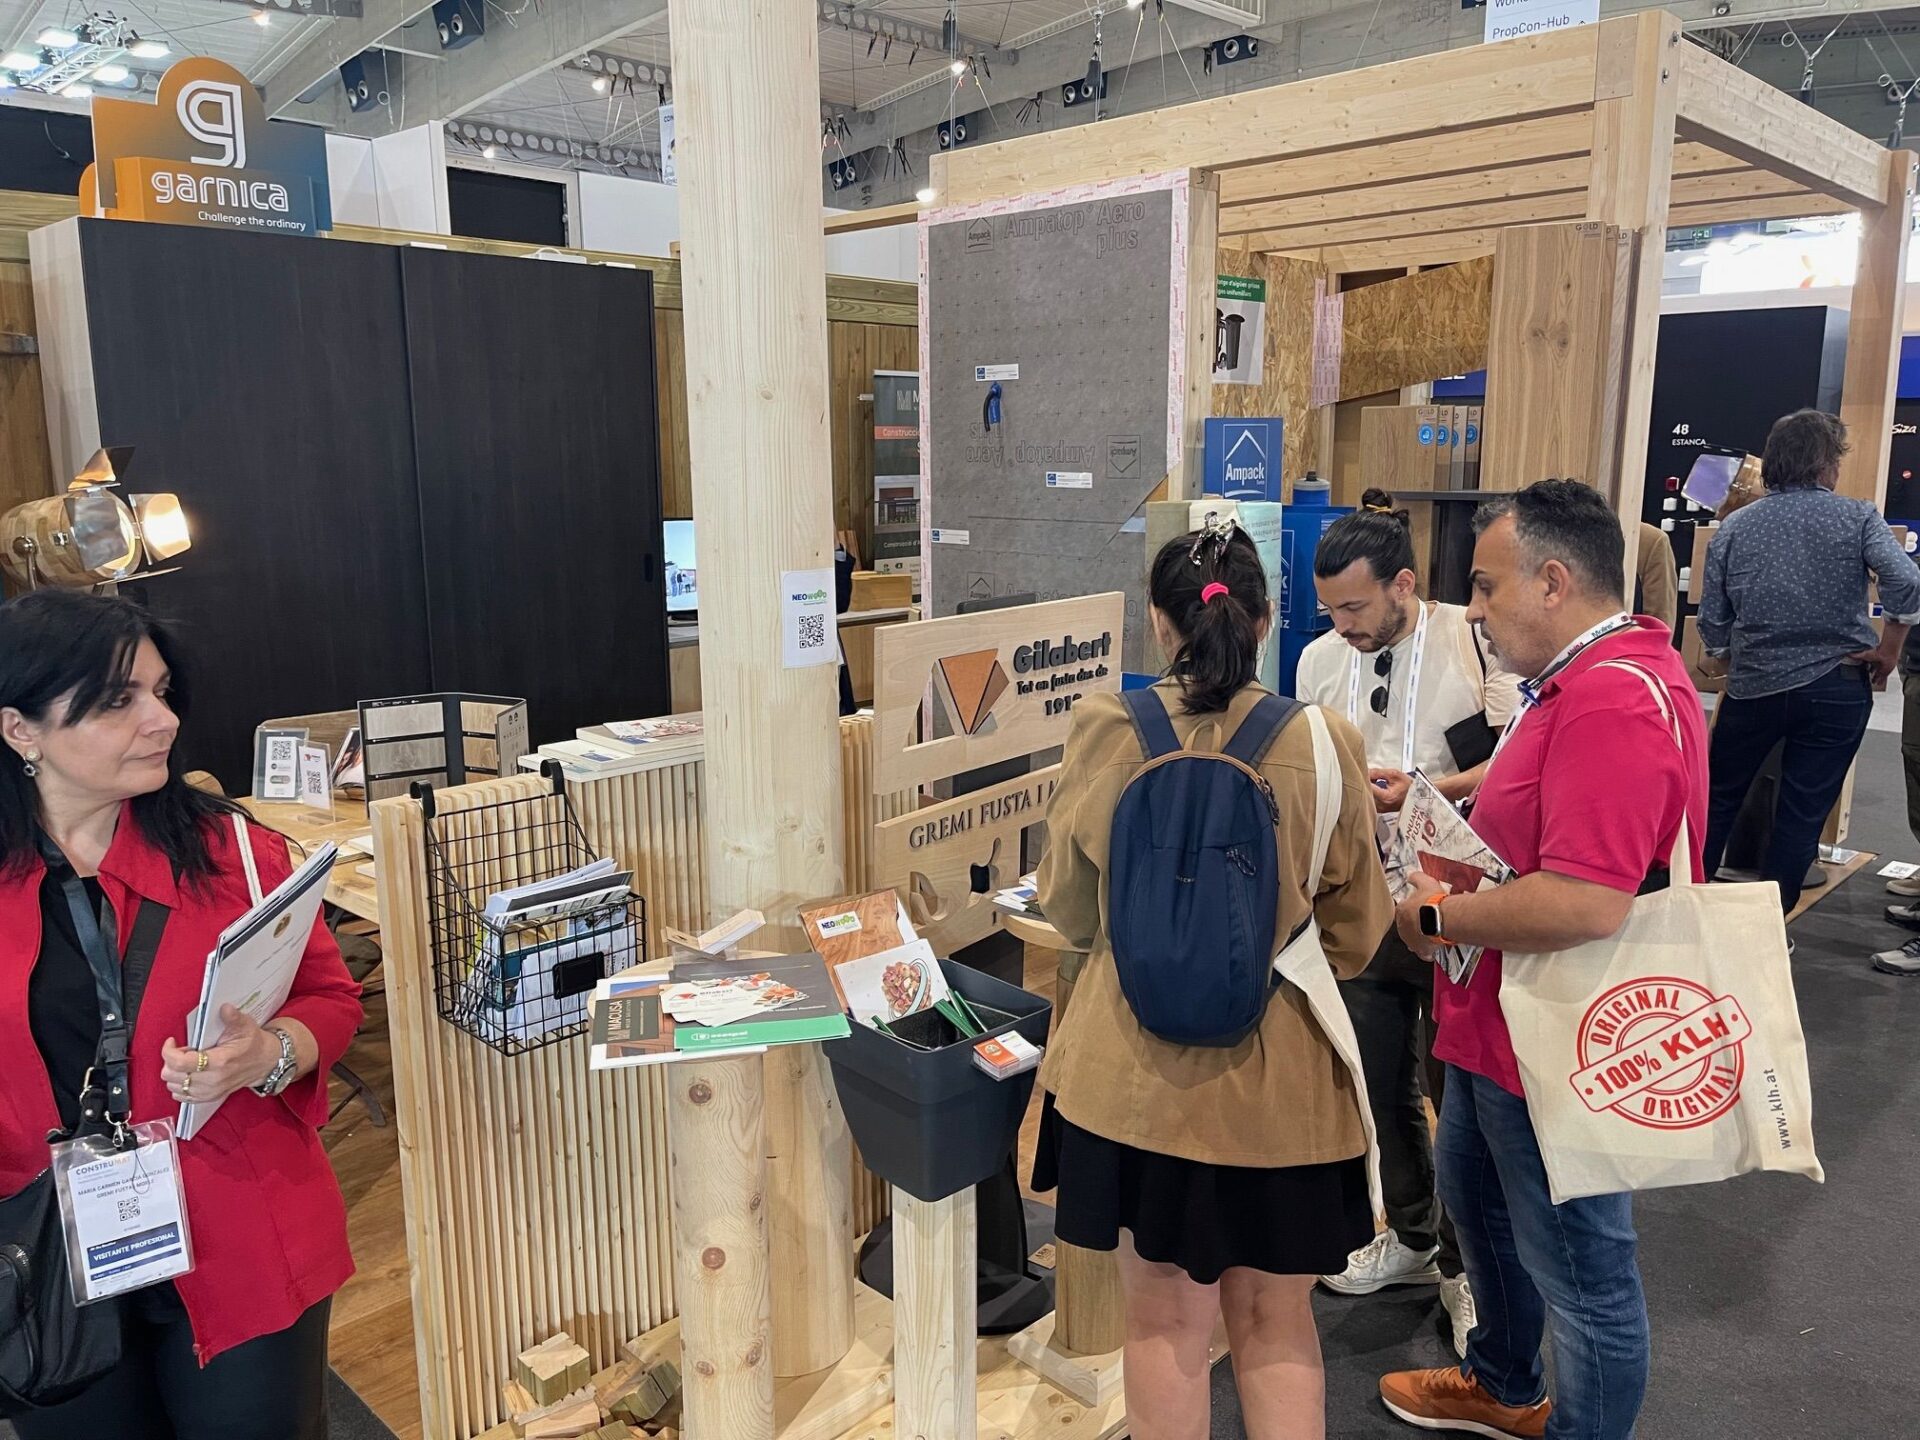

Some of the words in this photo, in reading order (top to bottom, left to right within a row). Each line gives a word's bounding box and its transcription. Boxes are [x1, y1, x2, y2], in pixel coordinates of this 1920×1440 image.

[1492, 14, 1570, 39] PropCon-Hub
[151, 171, 289, 212] garnica
[198, 210, 247, 226] Challenge
[248, 217, 265, 226] the
[267, 219, 306, 232] ordinary
[1096, 200, 1145, 226] Aero
[1096, 229, 1139, 260] plus
[1672, 423, 1690, 436] 48
[1672, 438, 1707, 446] ESTANCA
[1225, 463, 1265, 485] Ampack
[1013, 631, 1112, 673] Gilabert
[1016, 680, 1033, 695] Tot
[1035, 680, 1050, 691] en
[1050, 672, 1076, 692] fusta
[1076, 667, 1095, 682] des
[1095, 663, 1109, 678] de
[908, 806, 972, 850] GREMI
[979, 784, 1032, 826] FUSTA
[1405, 804, 1421, 843] ANUARI
[1410, 809, 1426, 844] FUSTA
[1421, 819, 1437, 847] 10
[608, 1000, 623, 1031] MACUSA
[1590, 987, 1682, 1047] ORIGINAL
[1594, 1049, 1662, 1096] 100%
[1659, 1011, 1731, 1062] KLH
[1642, 1065, 1736, 1119] ORIGINAL
[1763, 1068, 1792, 1150] www.klh.at
[94, 1246, 130, 1262] VISITANTE
[130, 1231, 176, 1251] PROFESIONAL
